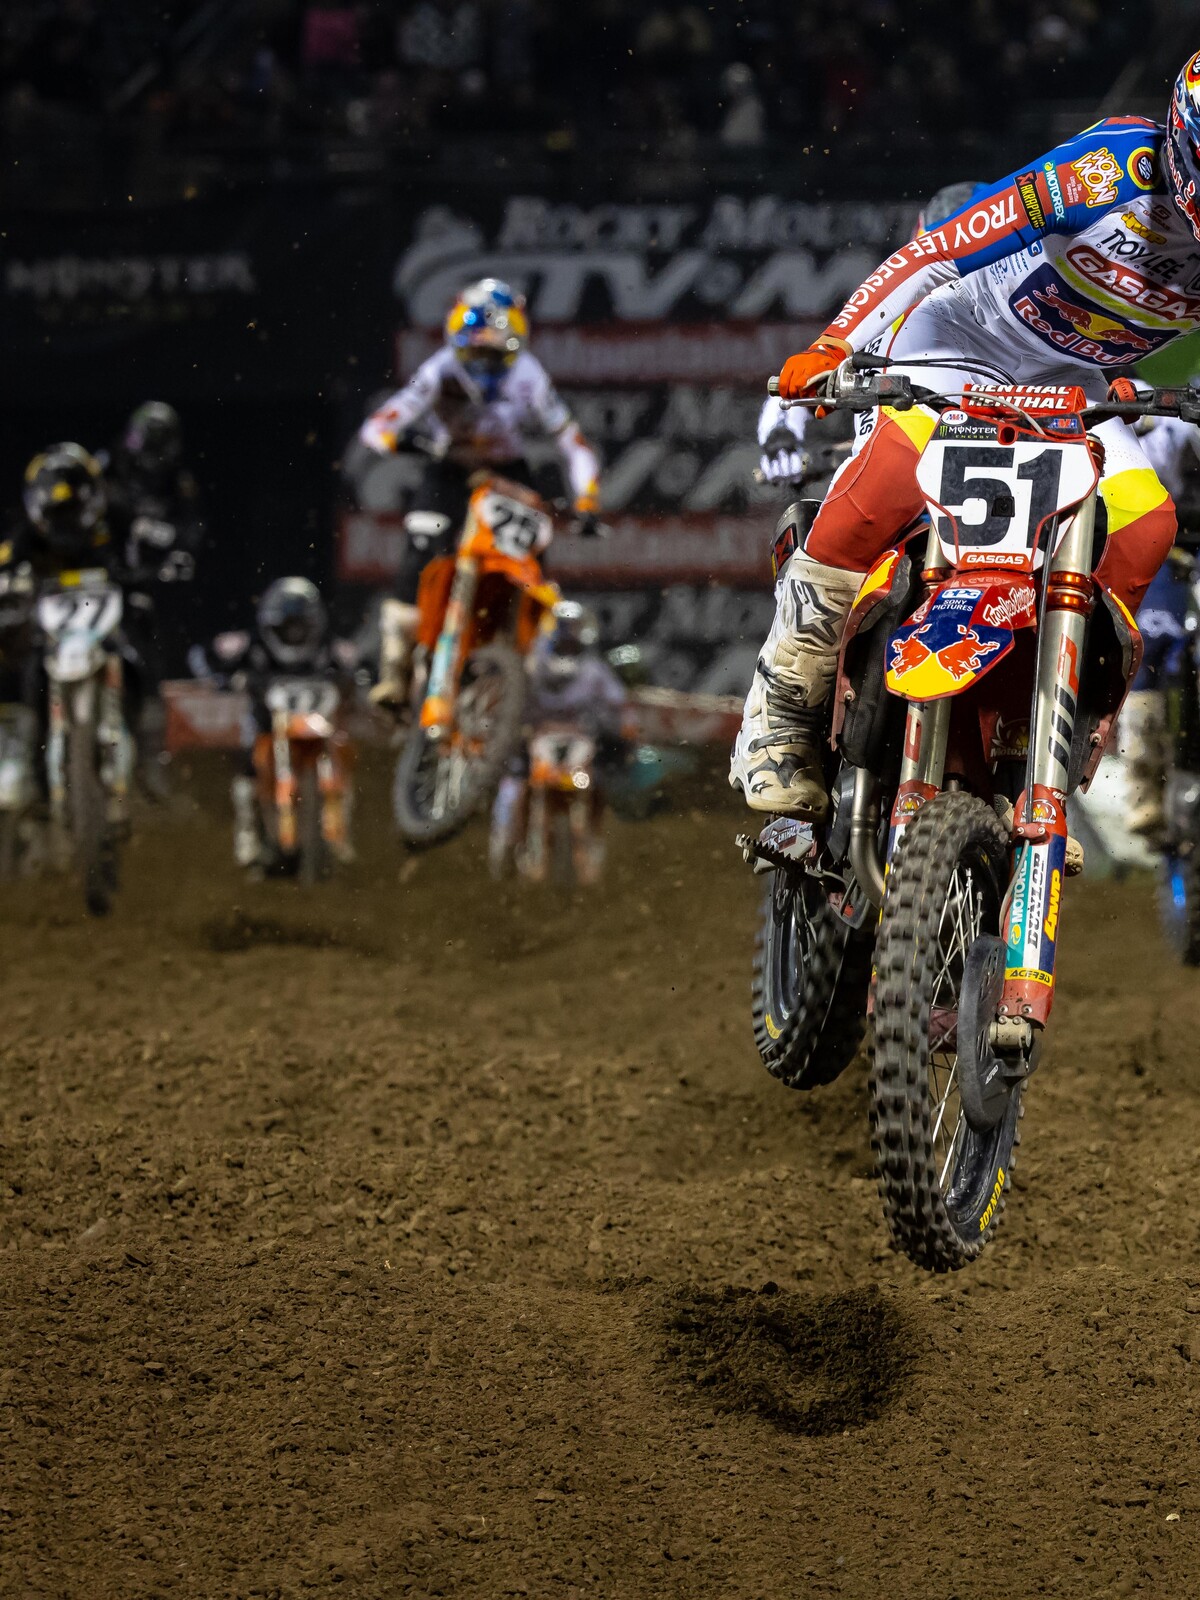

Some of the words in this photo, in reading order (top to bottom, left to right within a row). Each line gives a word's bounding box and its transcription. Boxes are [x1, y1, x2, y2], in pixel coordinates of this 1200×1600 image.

[1046, 170, 1065, 221] MOTOREX
[908, 230, 949, 258] LEE
[953, 194, 1018, 249] TROY
[1101, 228, 1153, 262] TROY
[1141, 254, 1185, 280] LEE
[832, 250, 909, 329] DESIGNS
[1013, 295, 1076, 348] Red
[1071, 336, 1146, 365] Bull
[969, 396, 1069, 410] RENTHAL
[970, 384, 1070, 395] RENTHAL
[949, 425, 997, 435] MONSTER
[937, 446, 1063, 549] 51
[966, 554, 1025, 565] GASGAS
[932, 604, 973, 612] PICTURES
[942, 589, 980, 599] PPG
[1012, 855, 1029, 924] MOTOR
[1027, 852, 1045, 950] DUNLOP
[980, 1167, 1005, 1231] DUNLOP
